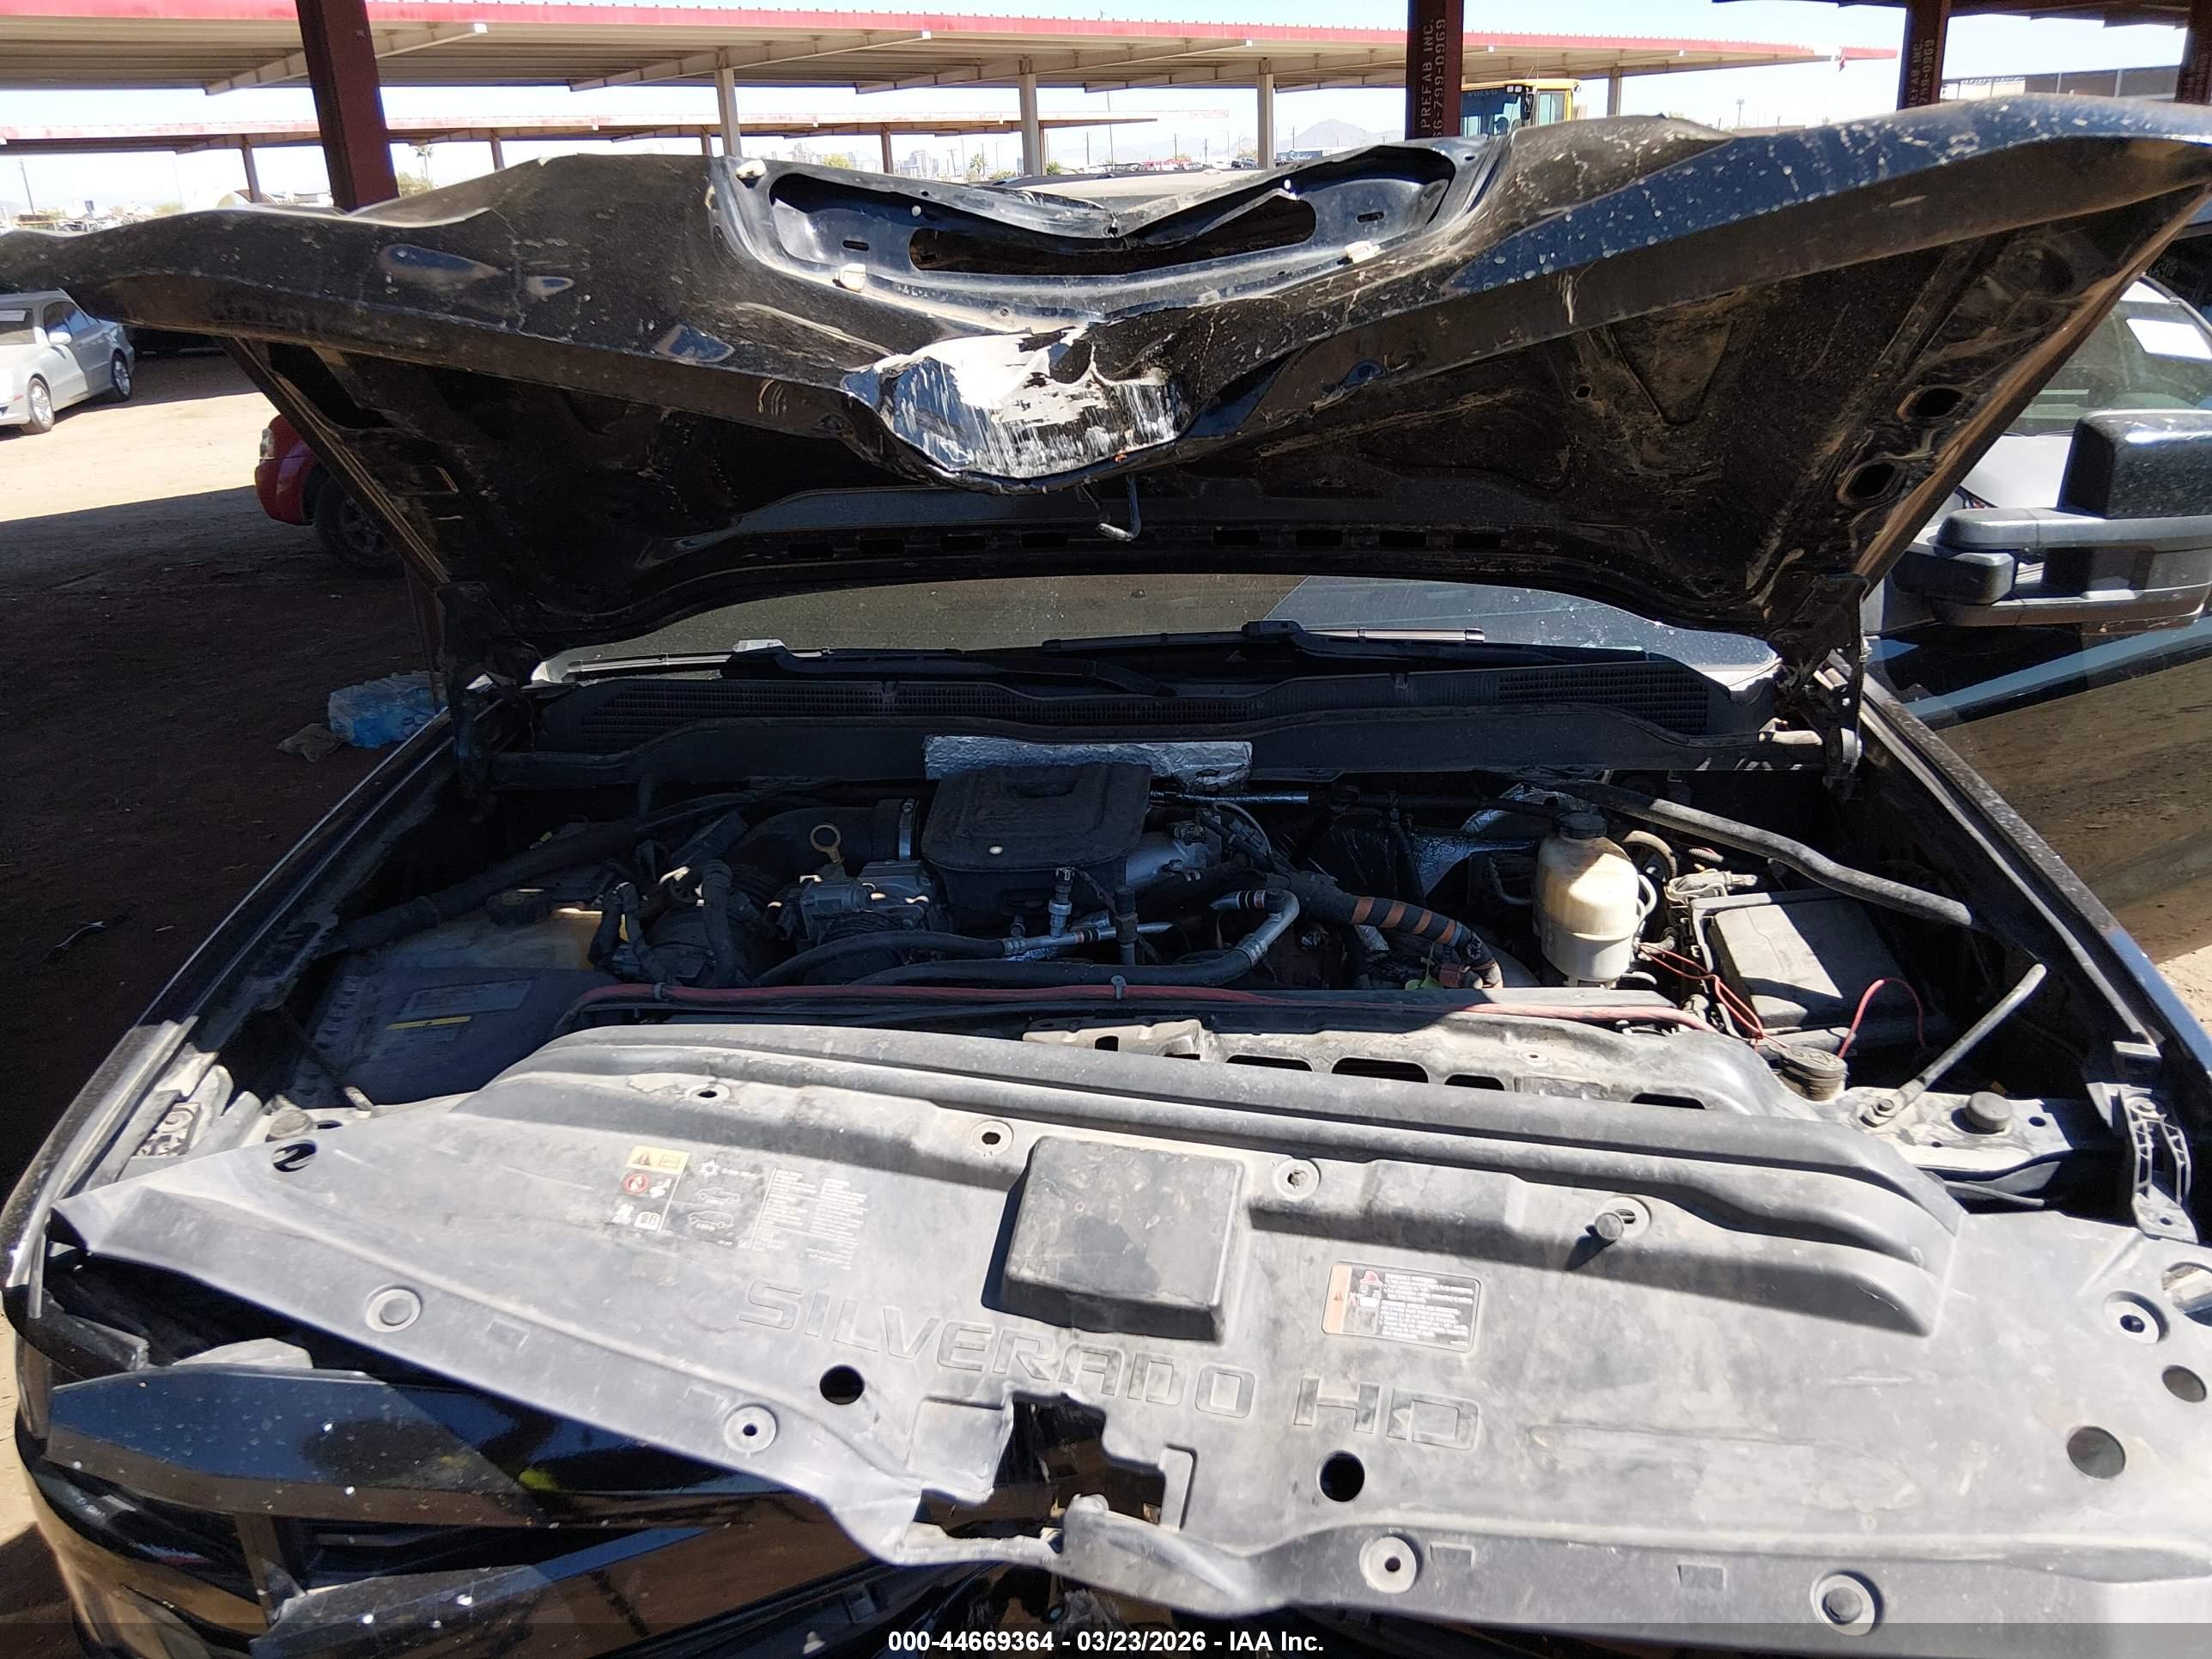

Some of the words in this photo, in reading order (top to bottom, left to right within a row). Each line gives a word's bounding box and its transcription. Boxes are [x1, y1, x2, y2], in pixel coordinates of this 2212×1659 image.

[1423, 18, 1434, 52] INC.
[1420, 61, 1432, 128] PREFAB
[738, 1284, 1256, 1419] SILVERADO
[1293, 1376, 1480, 1450] HD
